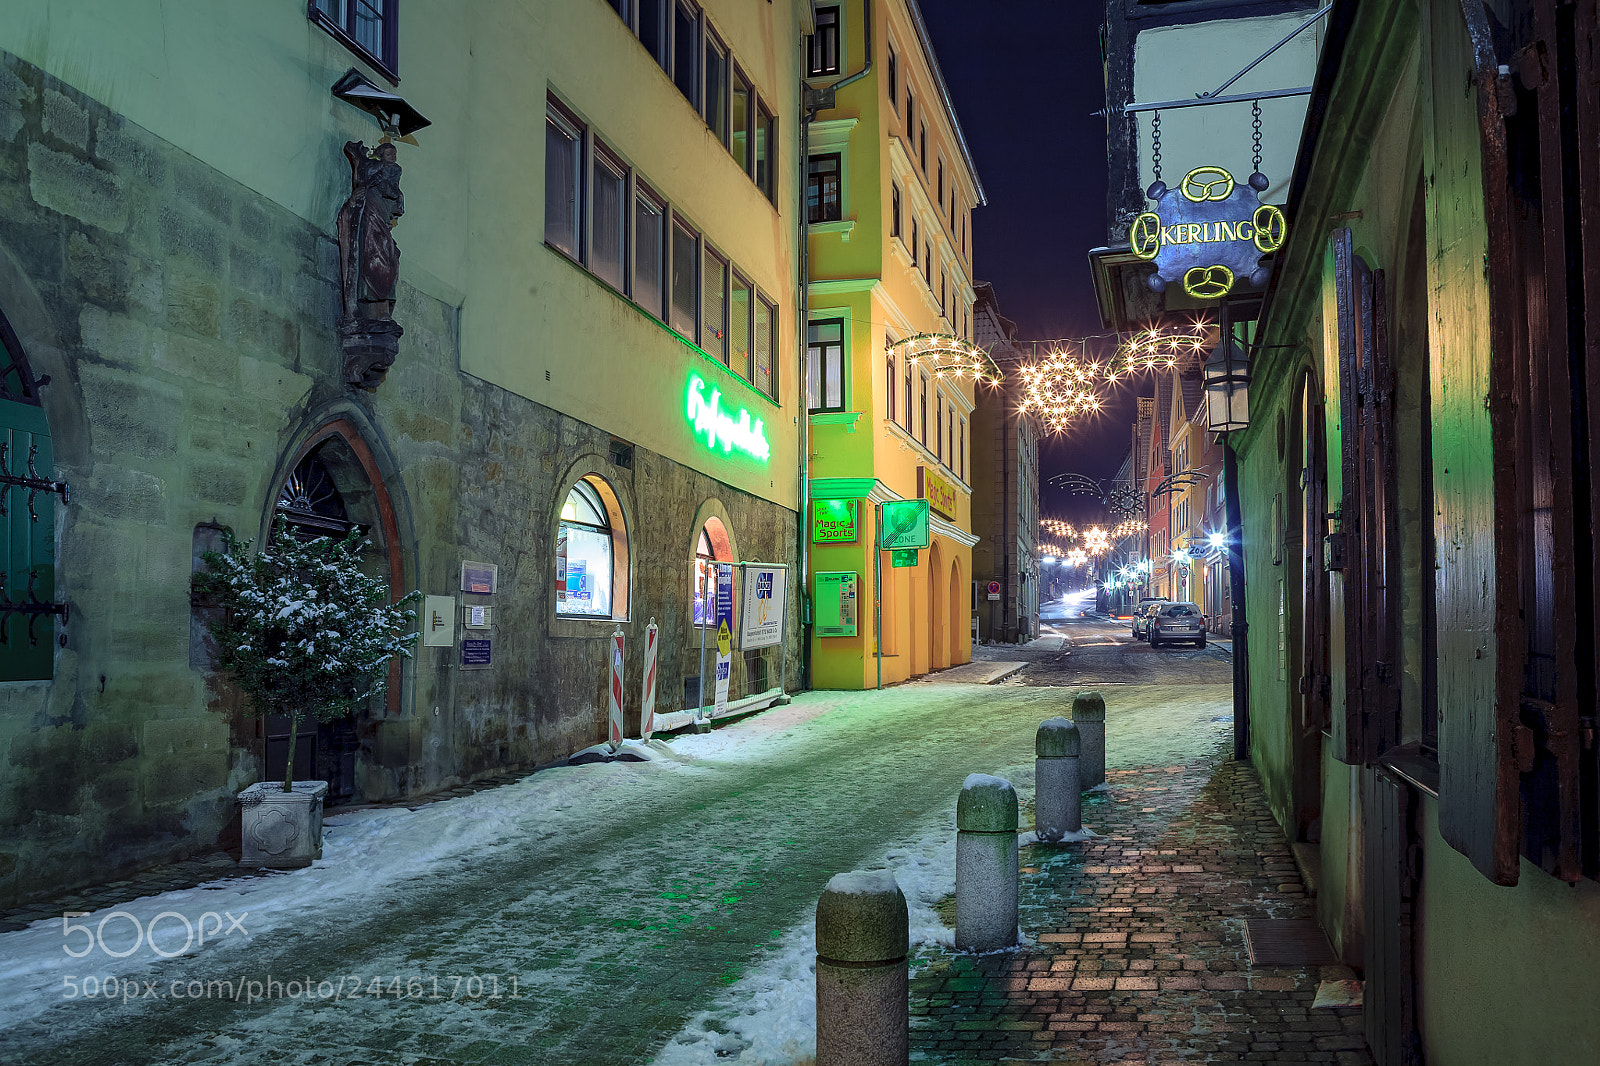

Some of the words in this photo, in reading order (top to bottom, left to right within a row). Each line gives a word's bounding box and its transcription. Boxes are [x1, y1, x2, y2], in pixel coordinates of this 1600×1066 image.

[1160, 221, 1253, 246] KERLING
[815, 519, 846, 530] Magic
[819, 528, 854, 540] Sports
